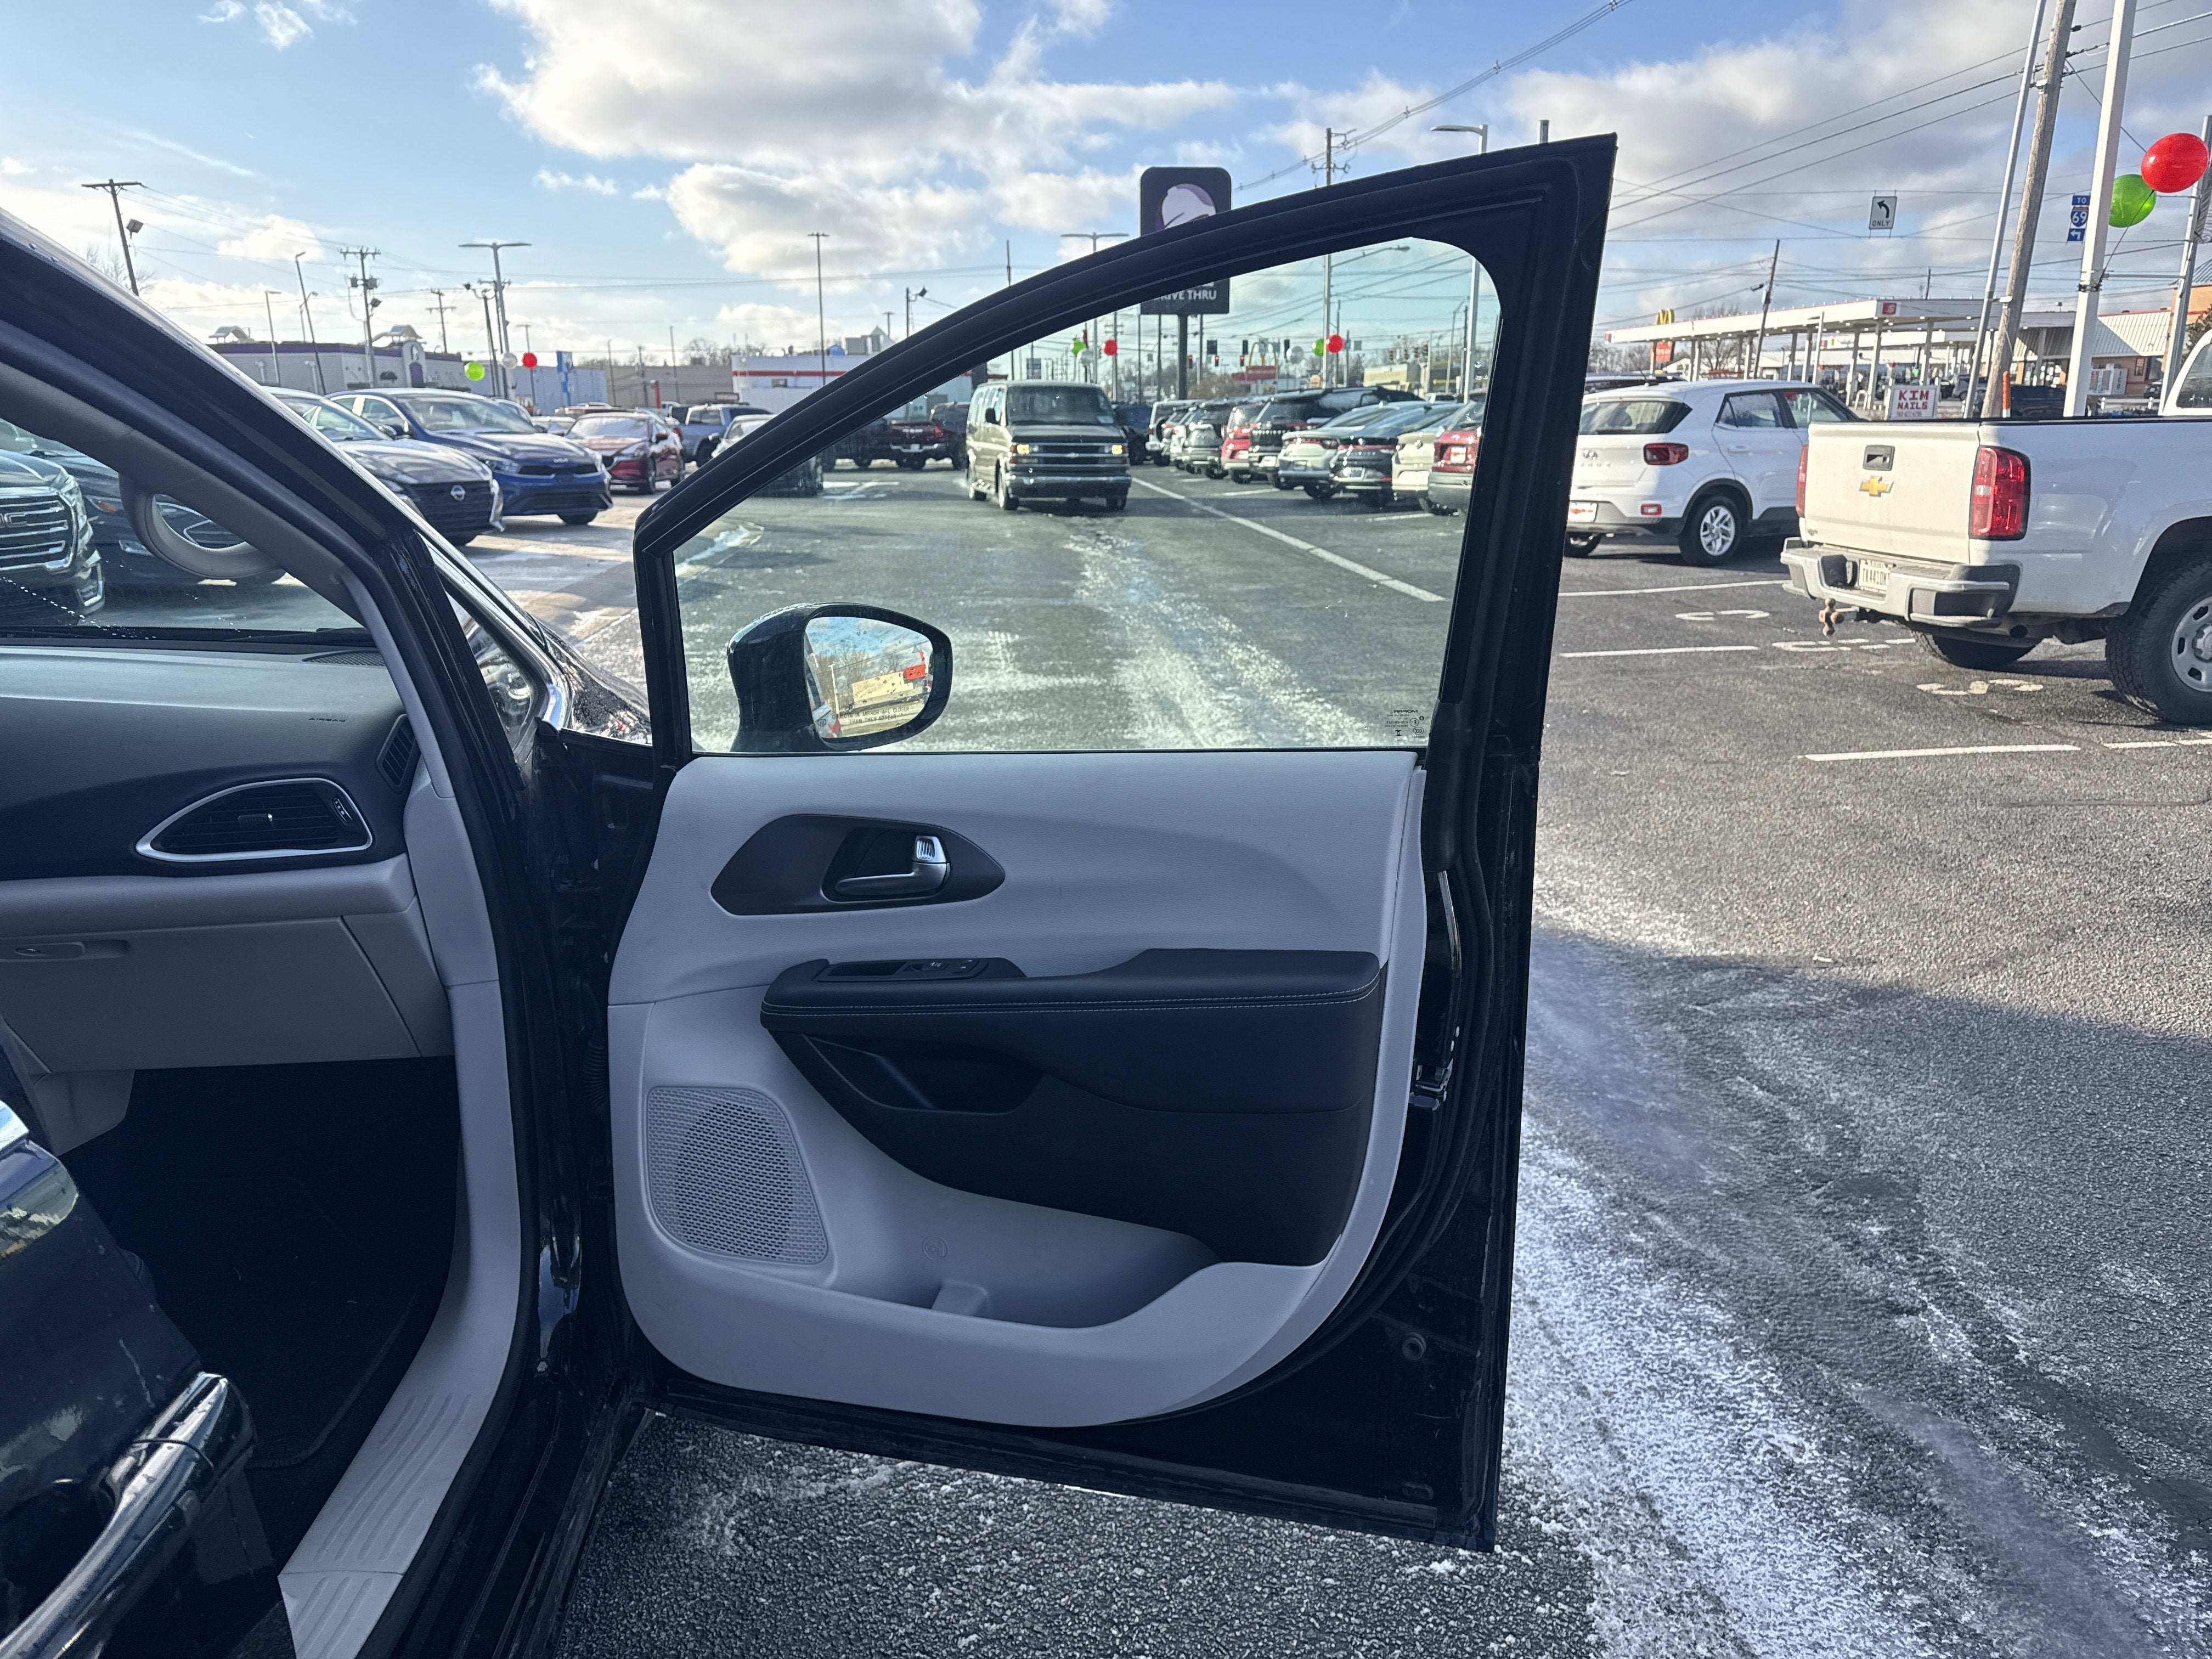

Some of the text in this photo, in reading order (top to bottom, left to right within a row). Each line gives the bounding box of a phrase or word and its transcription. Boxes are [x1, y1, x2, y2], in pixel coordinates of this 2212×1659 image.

[2072, 211, 2087, 224] 69
[1153, 290, 1217, 301] RIVE THRU
[1898, 390, 1929, 400] KIM
[1897, 402, 1928, 410] NAILS
